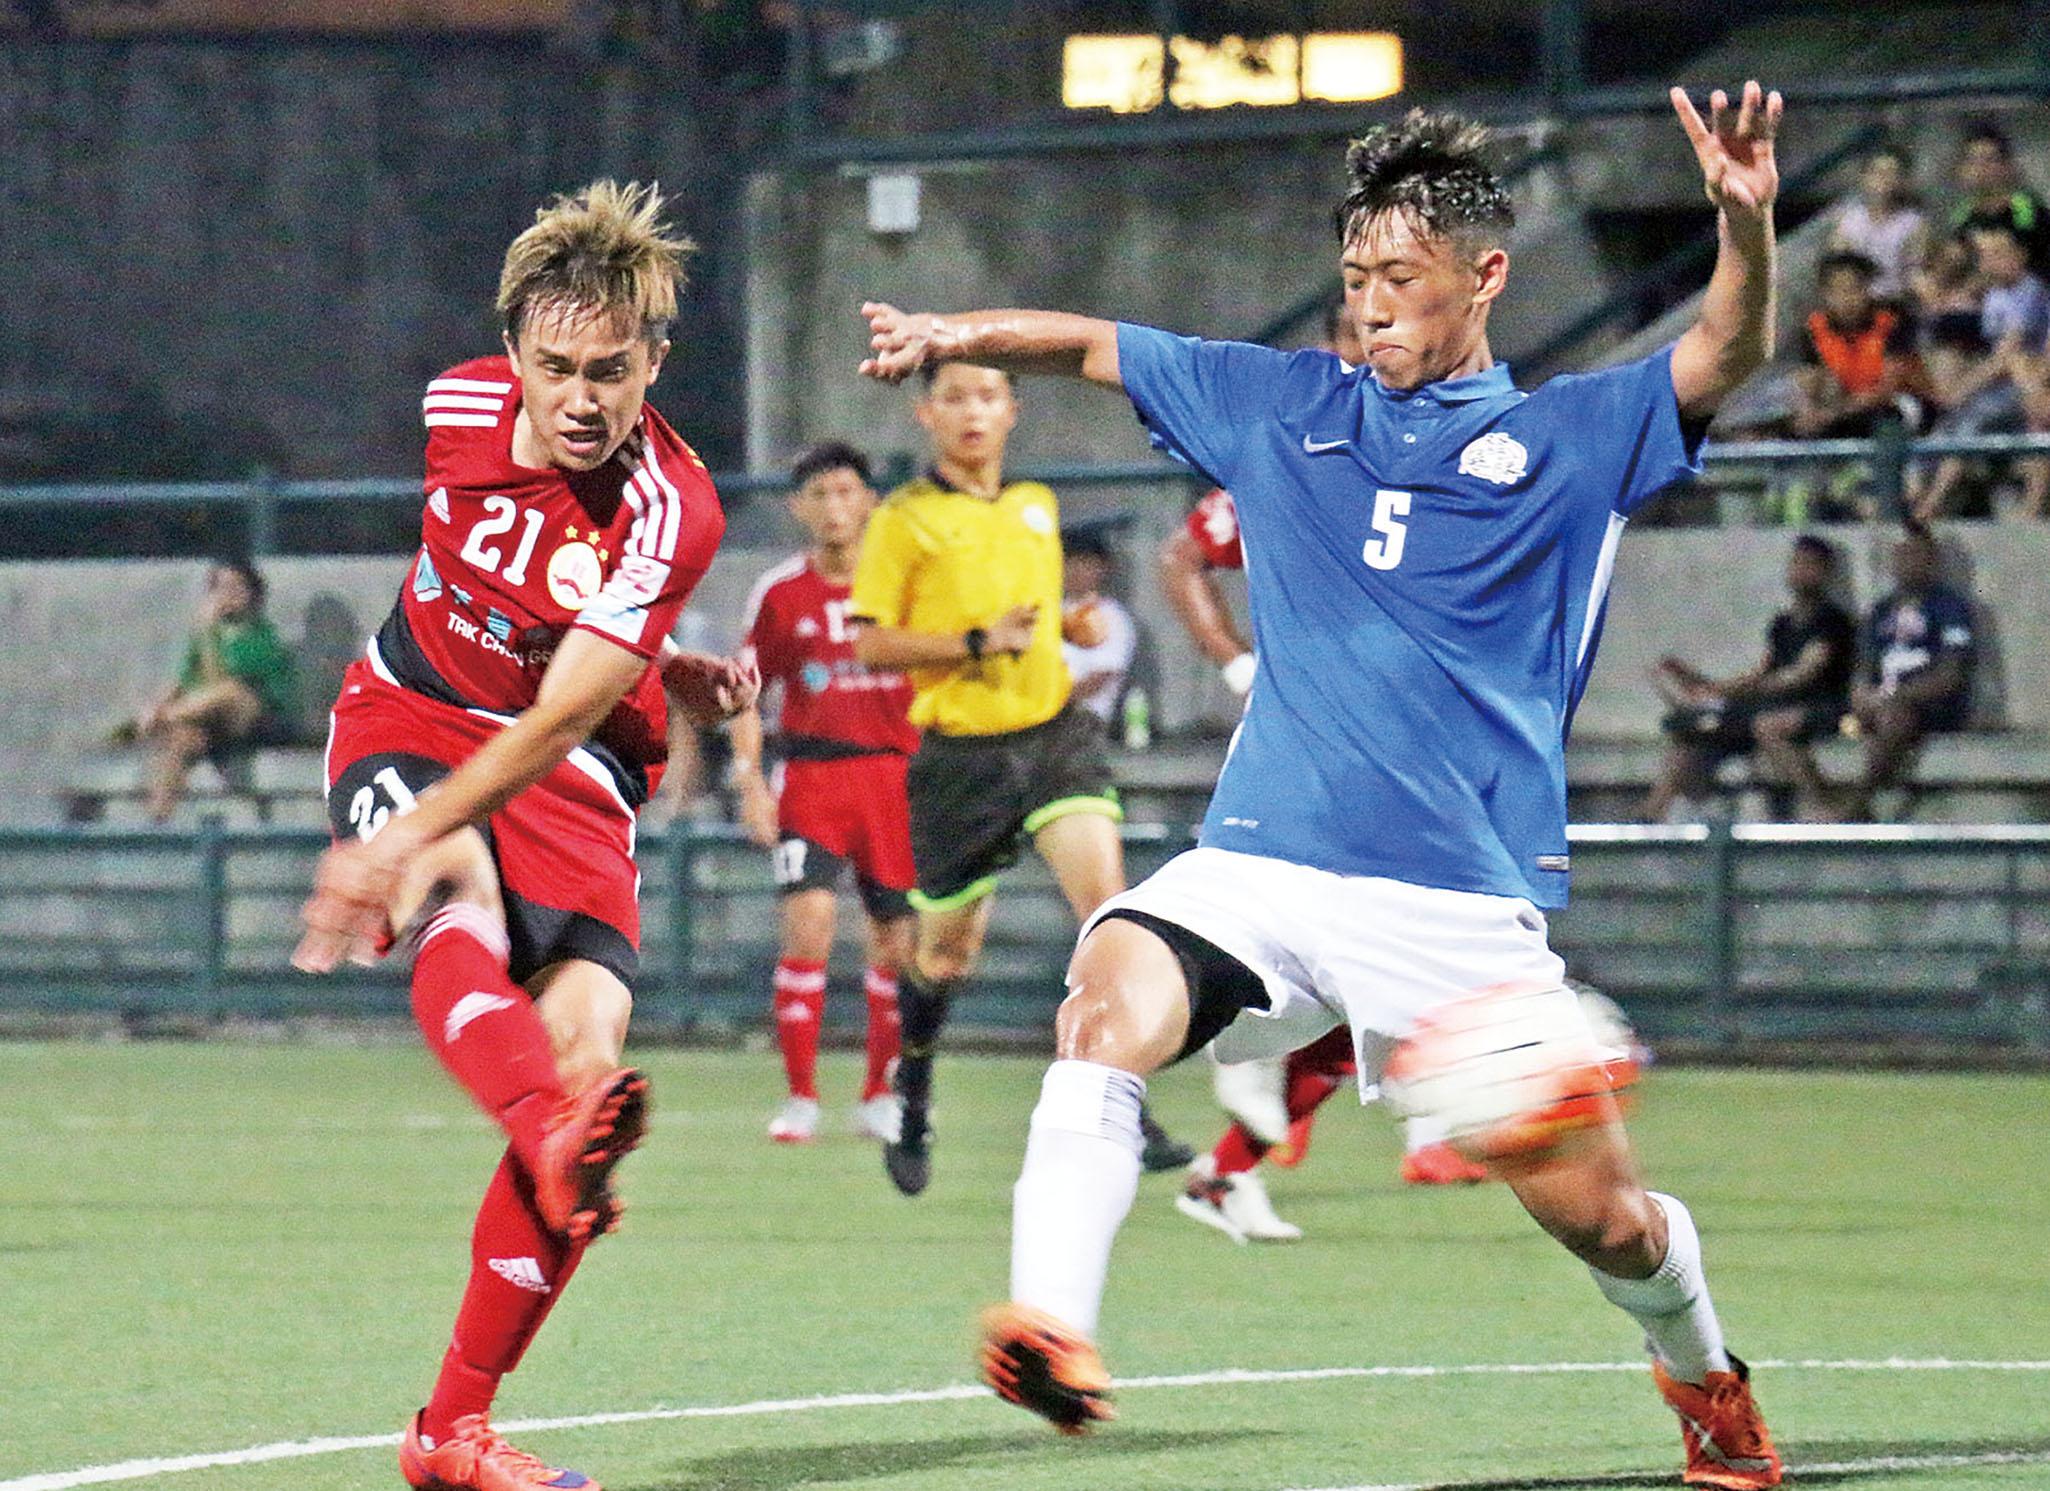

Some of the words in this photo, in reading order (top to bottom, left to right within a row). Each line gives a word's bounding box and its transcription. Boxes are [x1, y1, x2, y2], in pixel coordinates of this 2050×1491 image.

[460, 495, 545, 586] 21
[1363, 489, 1412, 571] 5
[447, 611, 479, 643] TAK
[349, 766, 418, 845] 21
